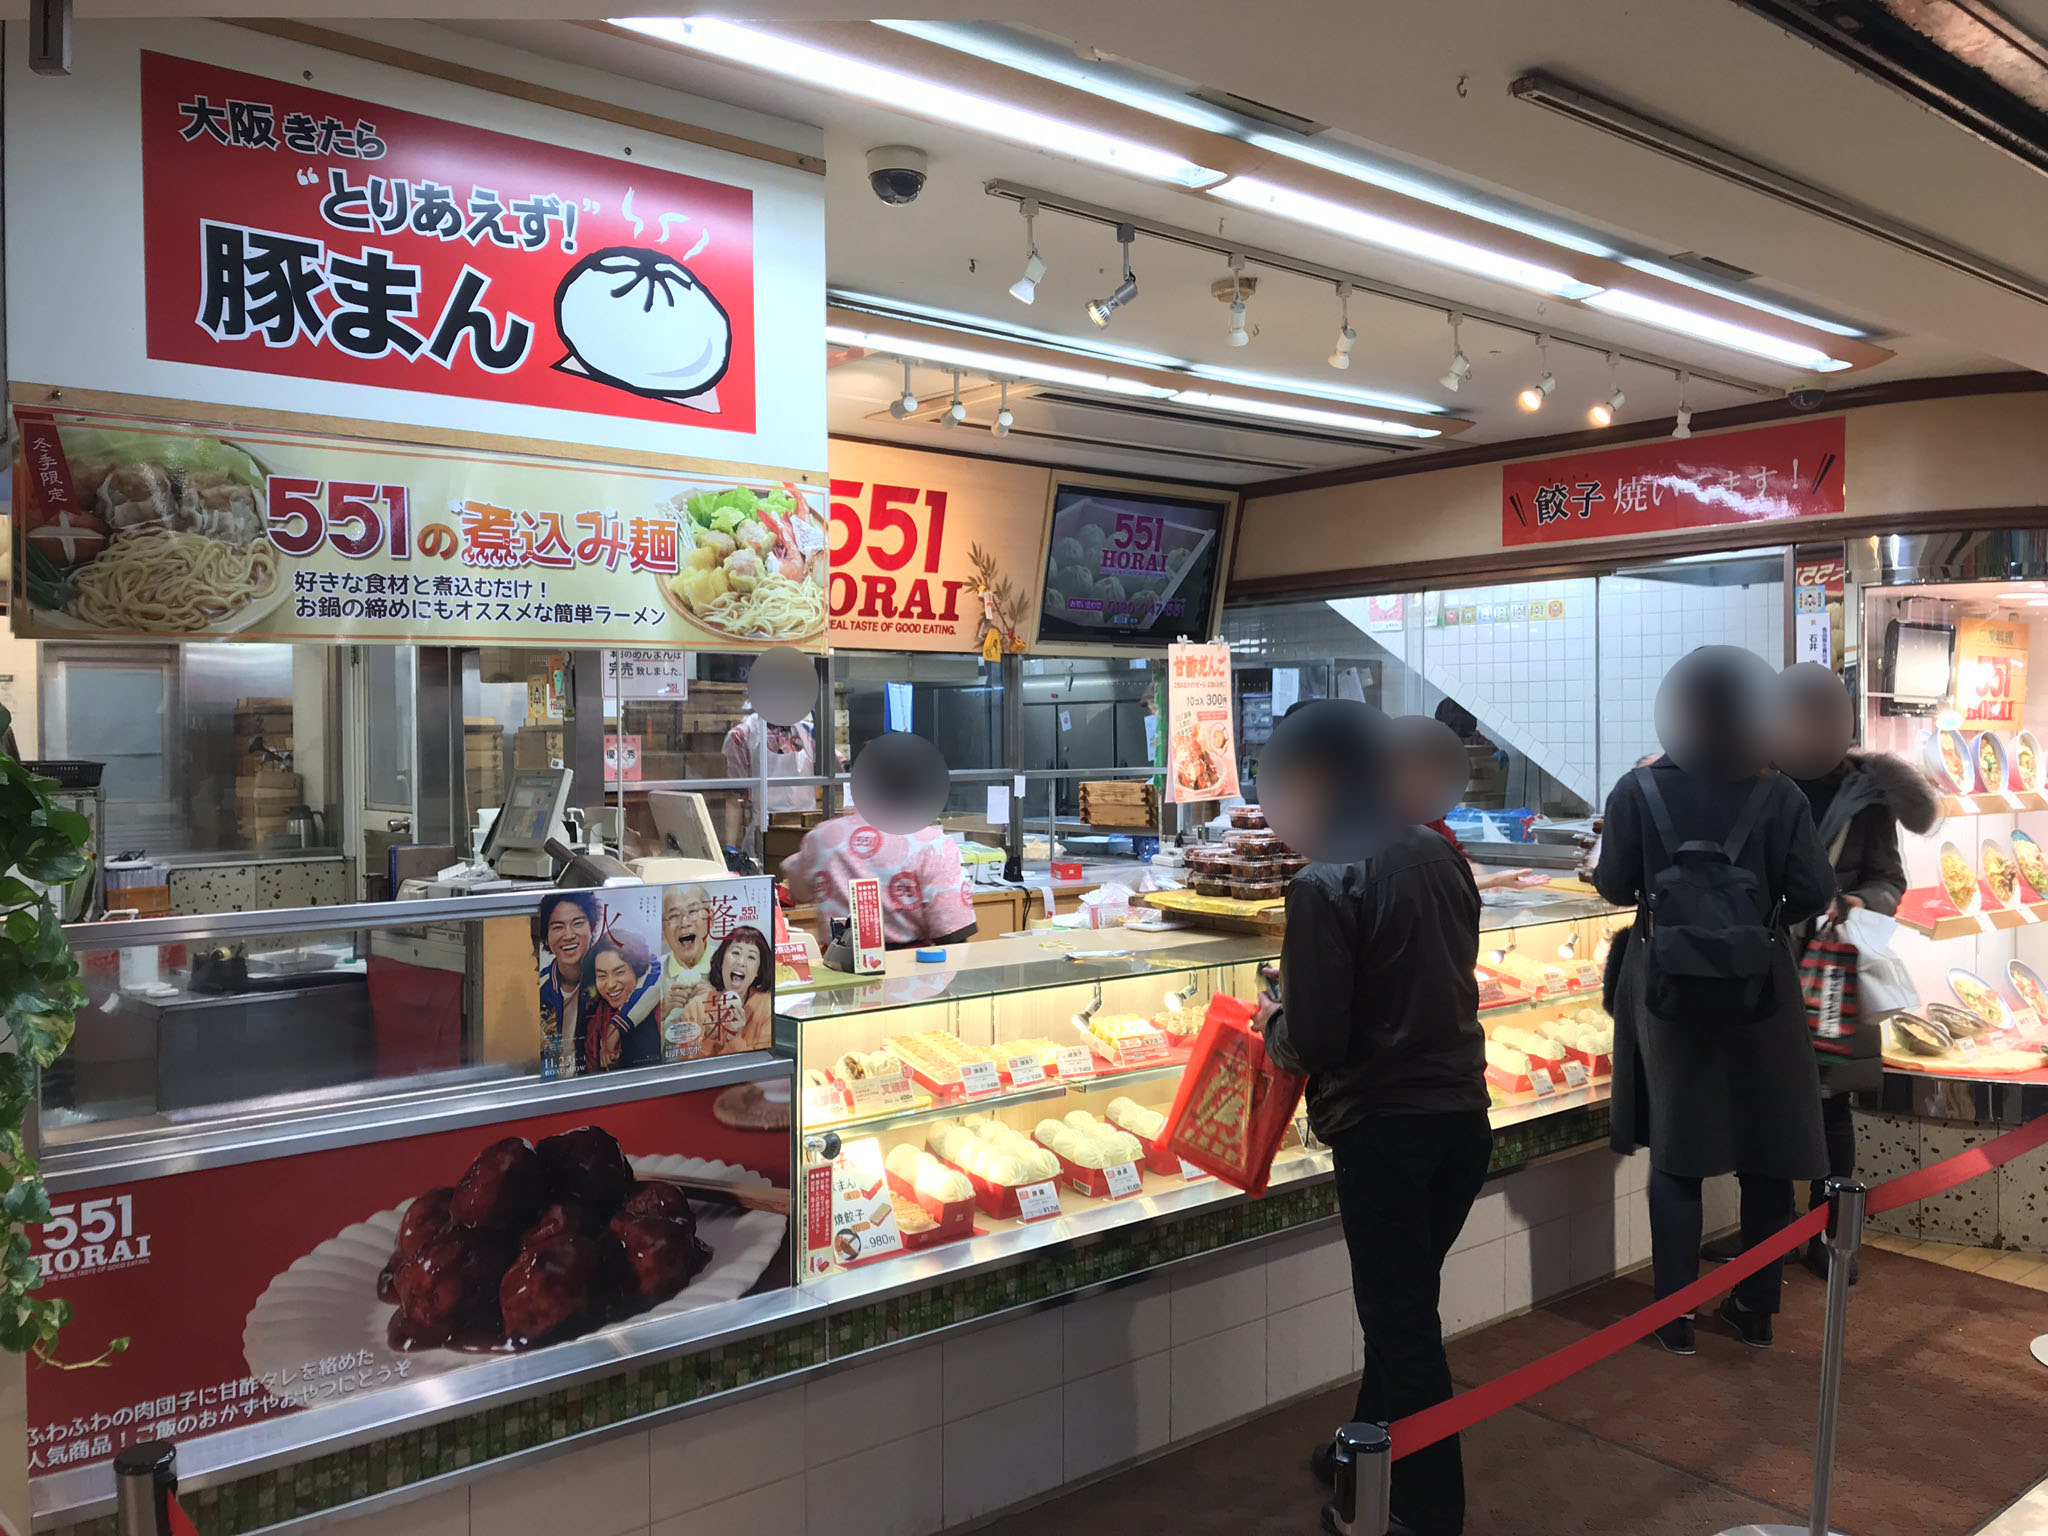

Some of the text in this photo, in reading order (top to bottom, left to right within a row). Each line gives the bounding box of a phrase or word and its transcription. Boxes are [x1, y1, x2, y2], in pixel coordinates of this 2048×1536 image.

[194, 217, 535, 375] 豚まん
[32, 436, 68, 503] 冬季限定
[1533, 479, 1606, 526] 餃子
[829, 479, 948, 574] 551
[1114, 513, 1165, 553] 551
[1101, 549, 1169, 573] HORAI
[294, 570, 548, 599] 好きな食材と煮込むだけ！
[829, 572, 964, 622] ORAI
[295, 596, 668, 626] お鍋の締めにもオススメな簡単ラーメン
[850, 620, 879, 632] TASTE
[880, 622, 894, 632] OF
[895, 623, 922, 634] GOOD
[742, 907, 757, 916] 551
[42, 1194, 133, 1250] 551
[869, 1234, 896, 1248] 980円
